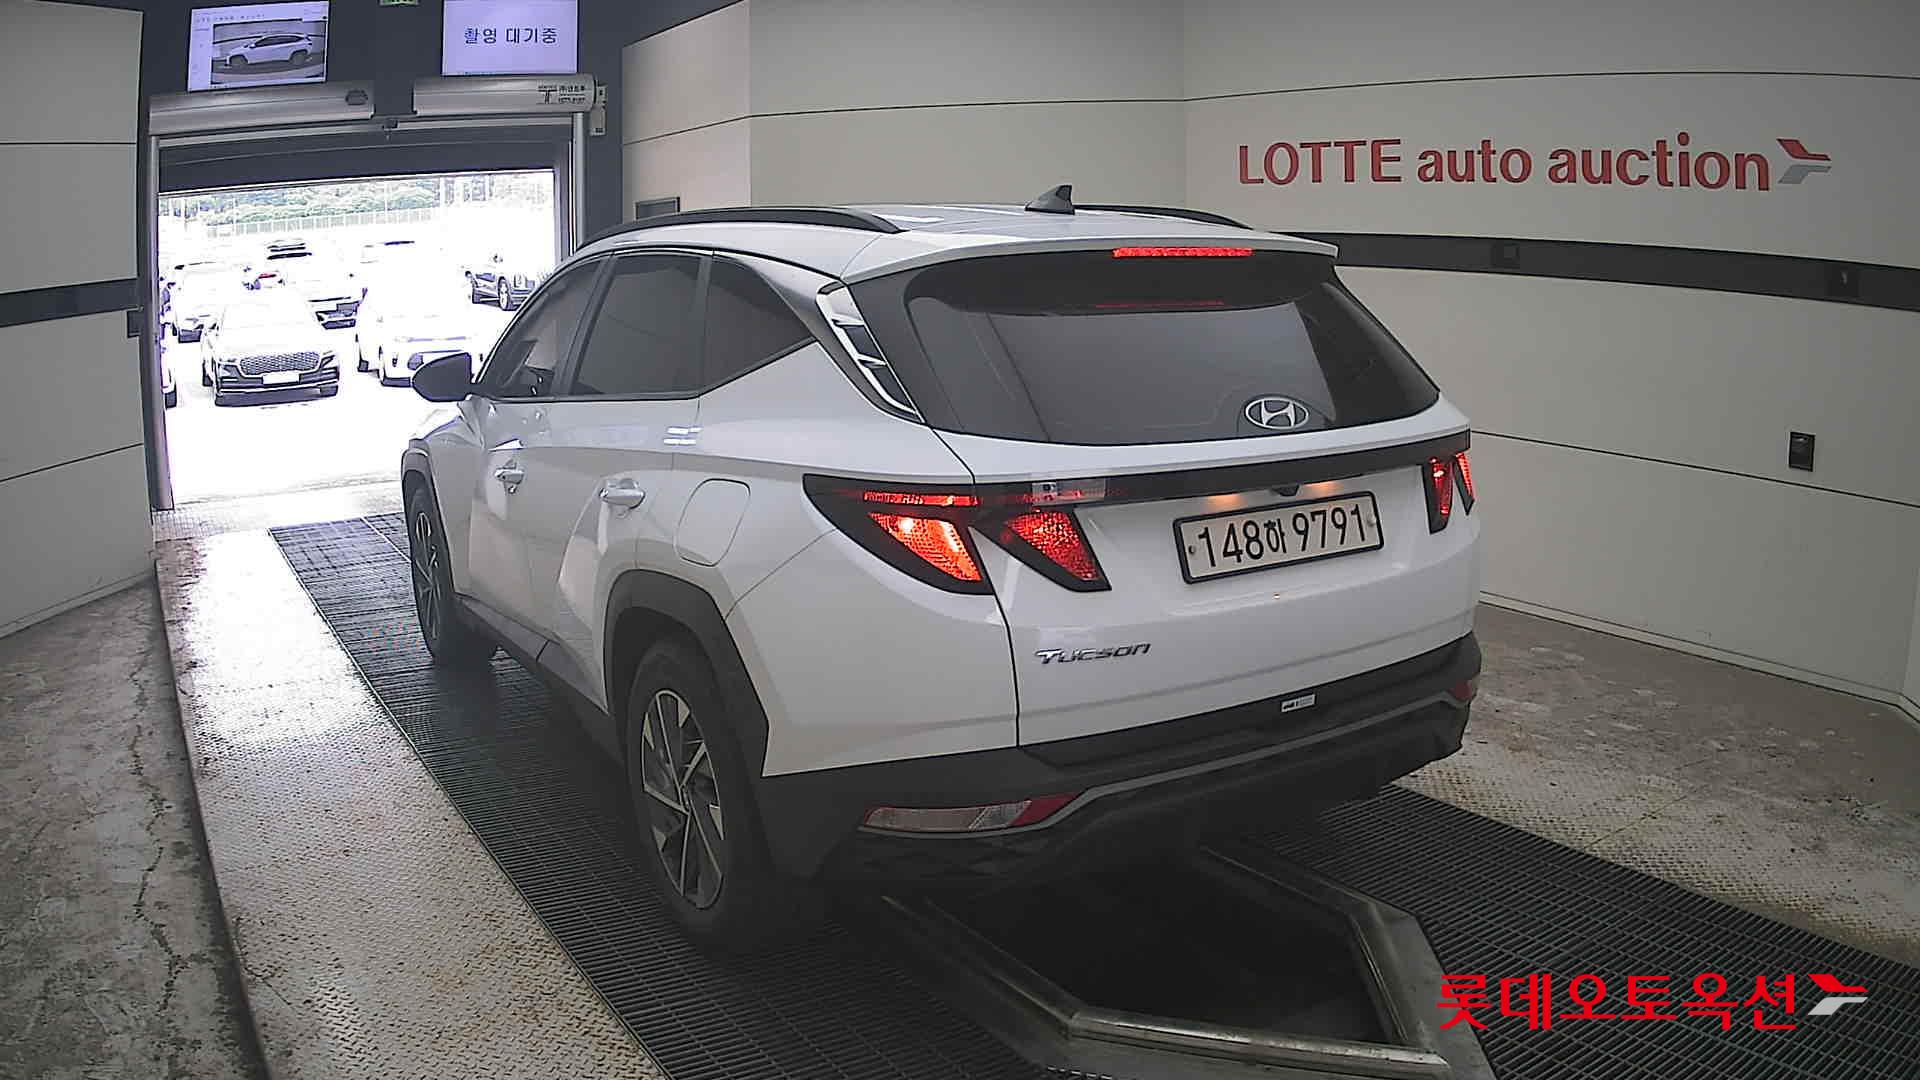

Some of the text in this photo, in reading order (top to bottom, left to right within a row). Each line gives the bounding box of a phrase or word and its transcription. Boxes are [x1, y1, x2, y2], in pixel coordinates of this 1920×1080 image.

[464, 27, 558, 45] 촬영 대기중
[1238, 131, 1771, 191] LOTTE auto auction
[1292, 503, 1366, 552] 9791
